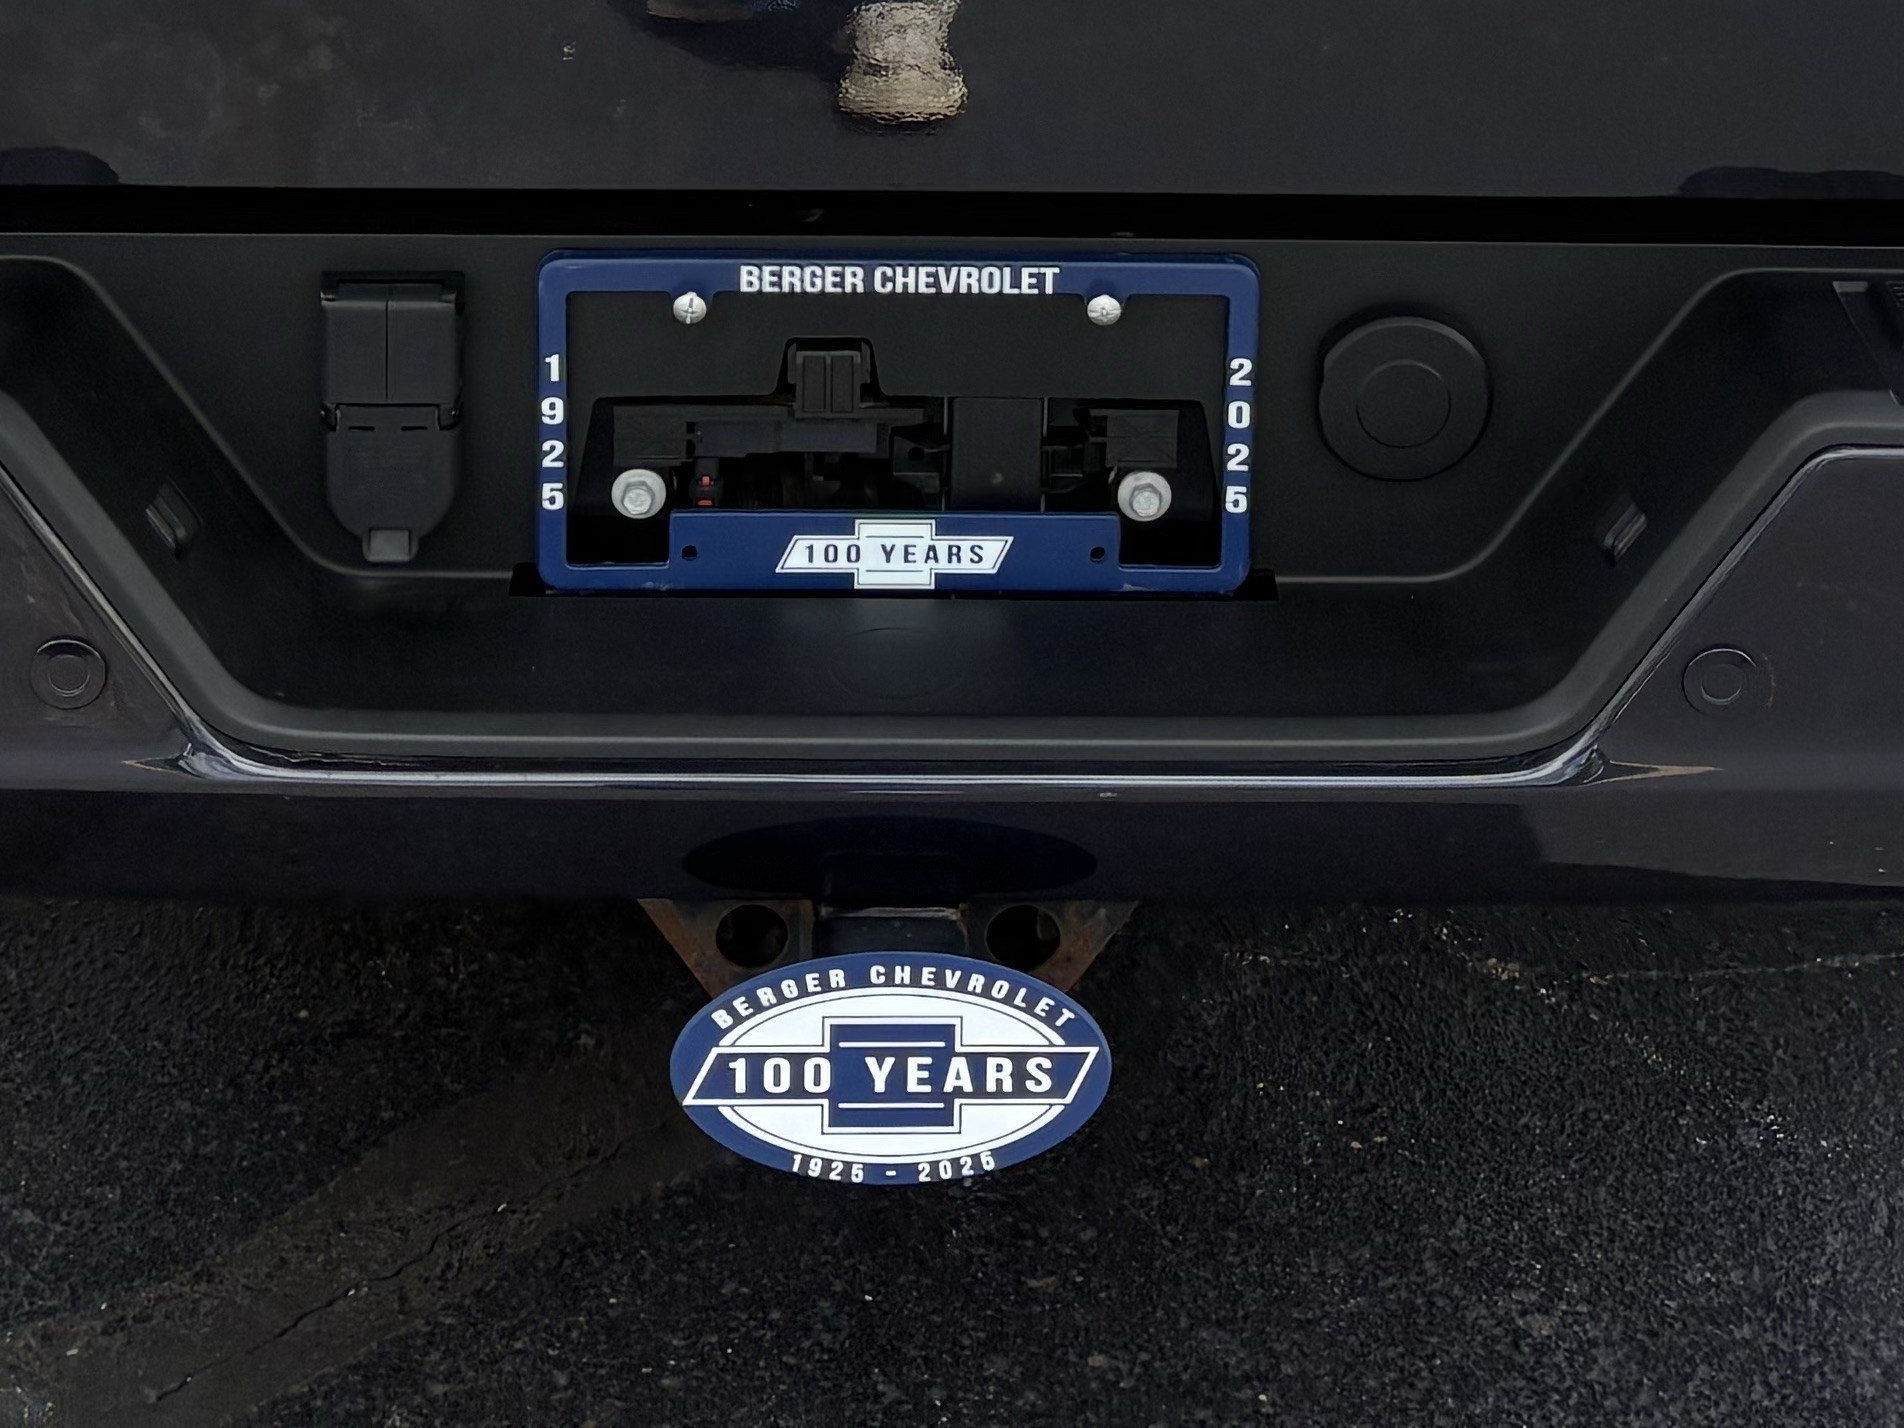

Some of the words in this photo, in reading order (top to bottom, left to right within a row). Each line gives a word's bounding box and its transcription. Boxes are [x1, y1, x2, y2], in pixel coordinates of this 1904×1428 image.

[739, 264, 865, 294] BERGER
[873, 265, 1061, 295] CHEVROLET
[540, 353, 565, 511] 1925
[1224, 357, 1253, 514] 2025
[804, 543, 862, 564] 100
[879, 543, 985, 564] YEARS
[710, 968, 847, 1030] BERGER
[869, 964, 1078, 1029] CHEVROLET
[727, 1056, 833, 1094] 100
[863, 1056, 1054, 1094] YEARS
[790, 1153, 865, 1184] 1925
[917, 1150, 996, 1183] 2025
